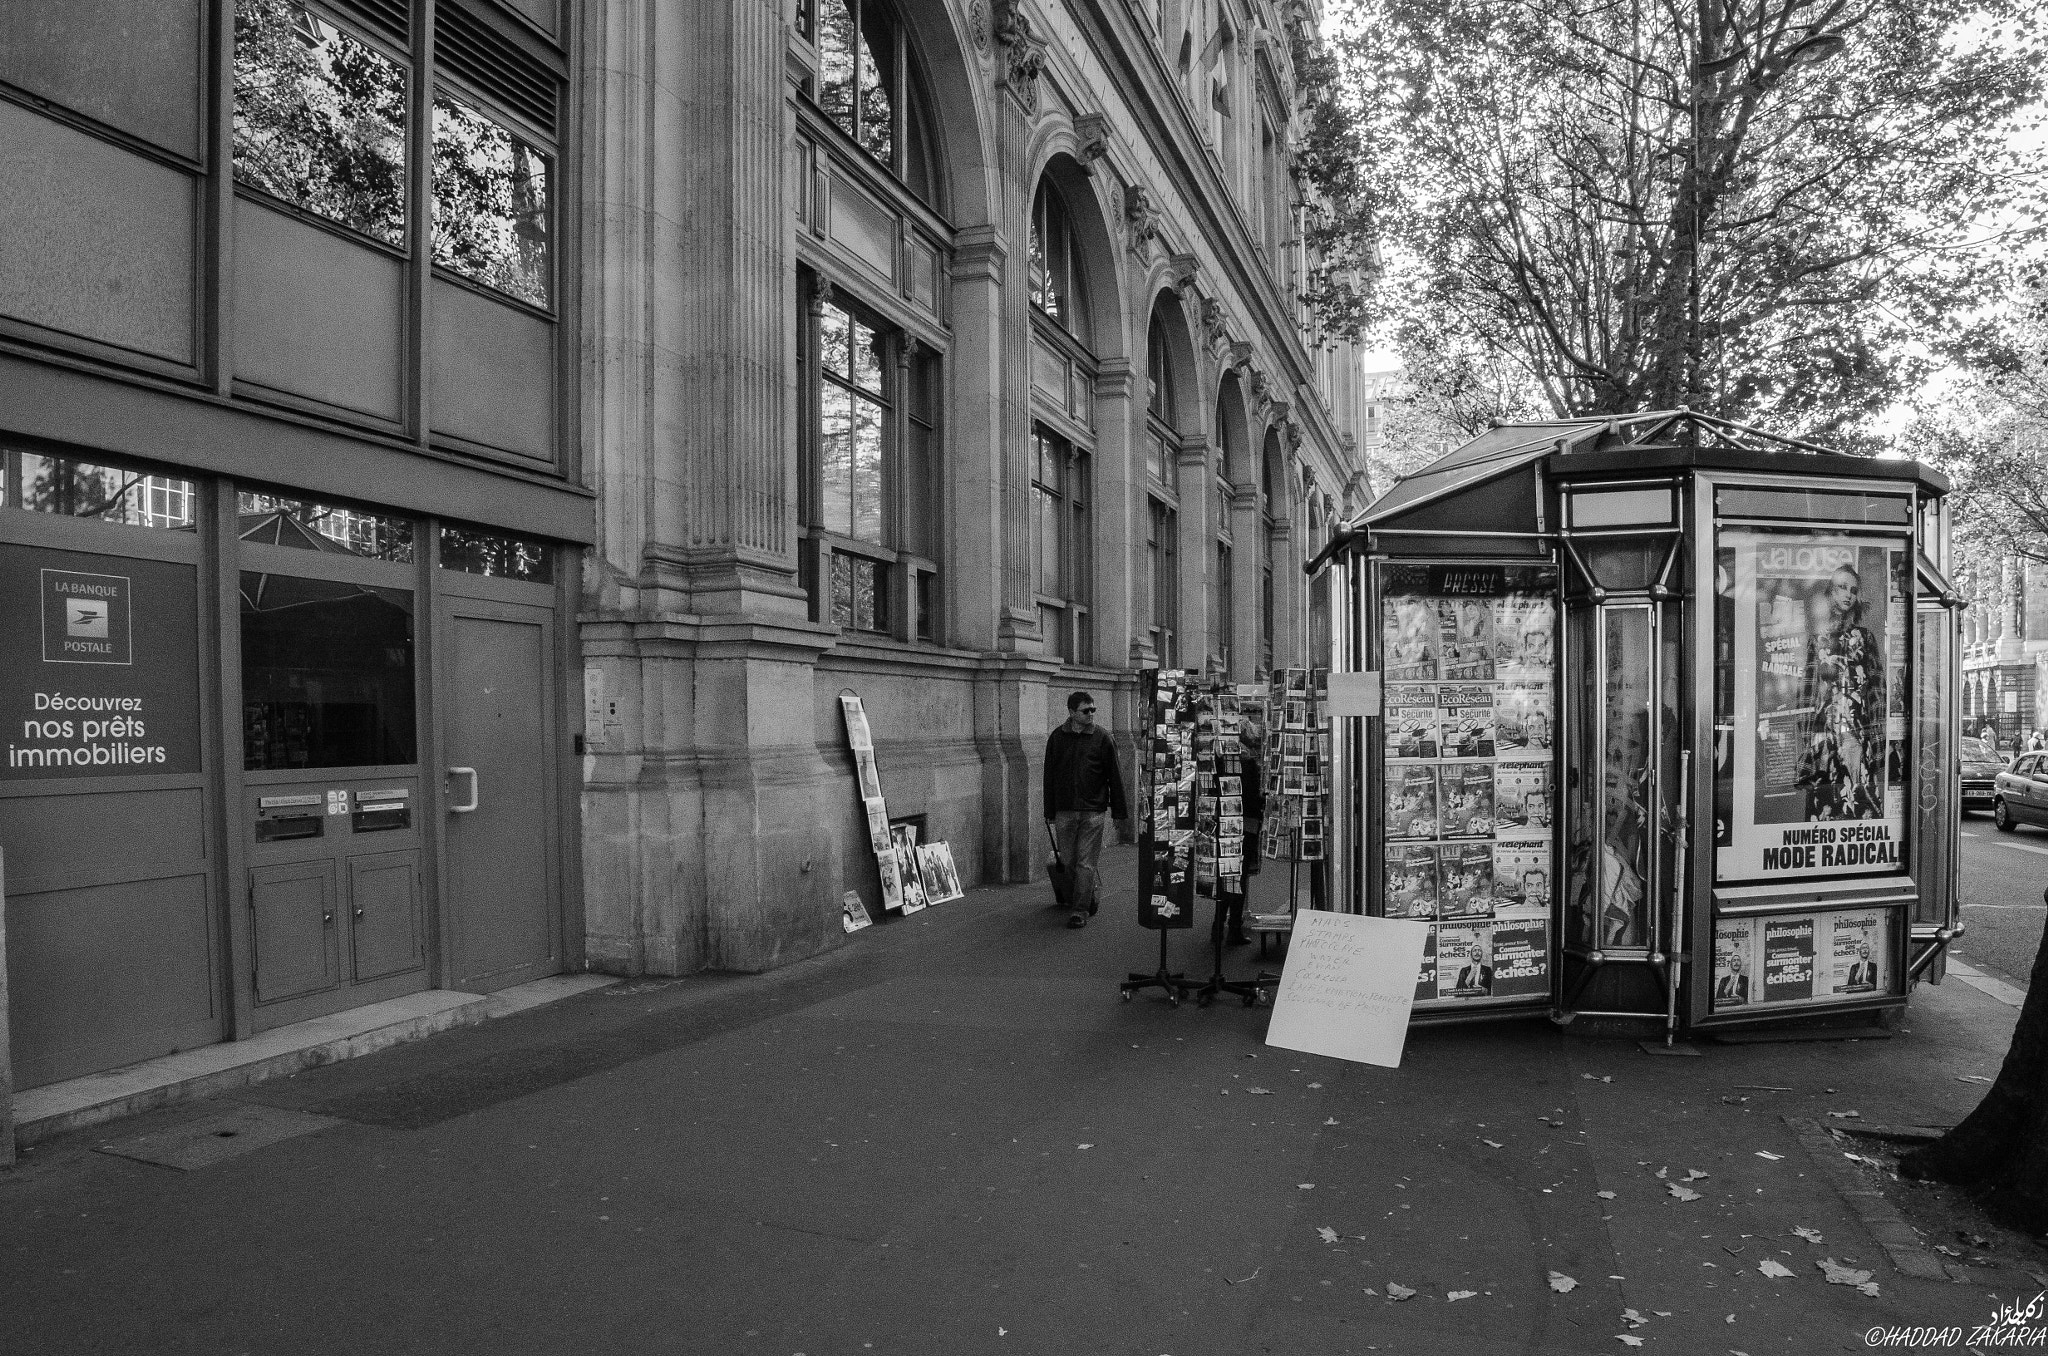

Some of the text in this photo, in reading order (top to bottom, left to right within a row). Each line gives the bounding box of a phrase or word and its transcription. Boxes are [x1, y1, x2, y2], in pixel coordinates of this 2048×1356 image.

[55, 581, 118, 597] LA BANQUE
[1442, 573, 1497, 592] PRESSE
[64, 641, 113, 654] POSTALE
[1765, 637, 1801, 652] SPÉCIAL
[1771, 652, 1795, 663] MODE
[1762, 661, 1804, 677] RADICALE
[34, 692, 142, 711] Découvrez
[1440, 693, 1492, 704] EcoRéseau
[1401, 708, 1433, 719] Sécurité
[1460, 708, 1491, 719] Sécurité
[24, 715, 145, 742] nos prêts
[9, 743, 167, 767] immobiliers
[1782, 823, 1891, 846] NUMÉRO SPÉCIAL
[1762, 846, 1816, 870] MODE
[1492, 919, 1545, 935] philosophie
[1834, 917, 1877, 932] philosophie
[1306, 929, 1356, 942] STAMPS
[1715, 928, 1749, 941] losophie
[1766, 925, 1812, 941] philosophie
[1493, 949, 1546, 961] surmonter
[1499, 945, 1531, 953] Comment
[1513, 958, 1532, 968] ses
[1766, 956, 1812, 967] surmonter
[1782, 965, 1800, 974] ses
